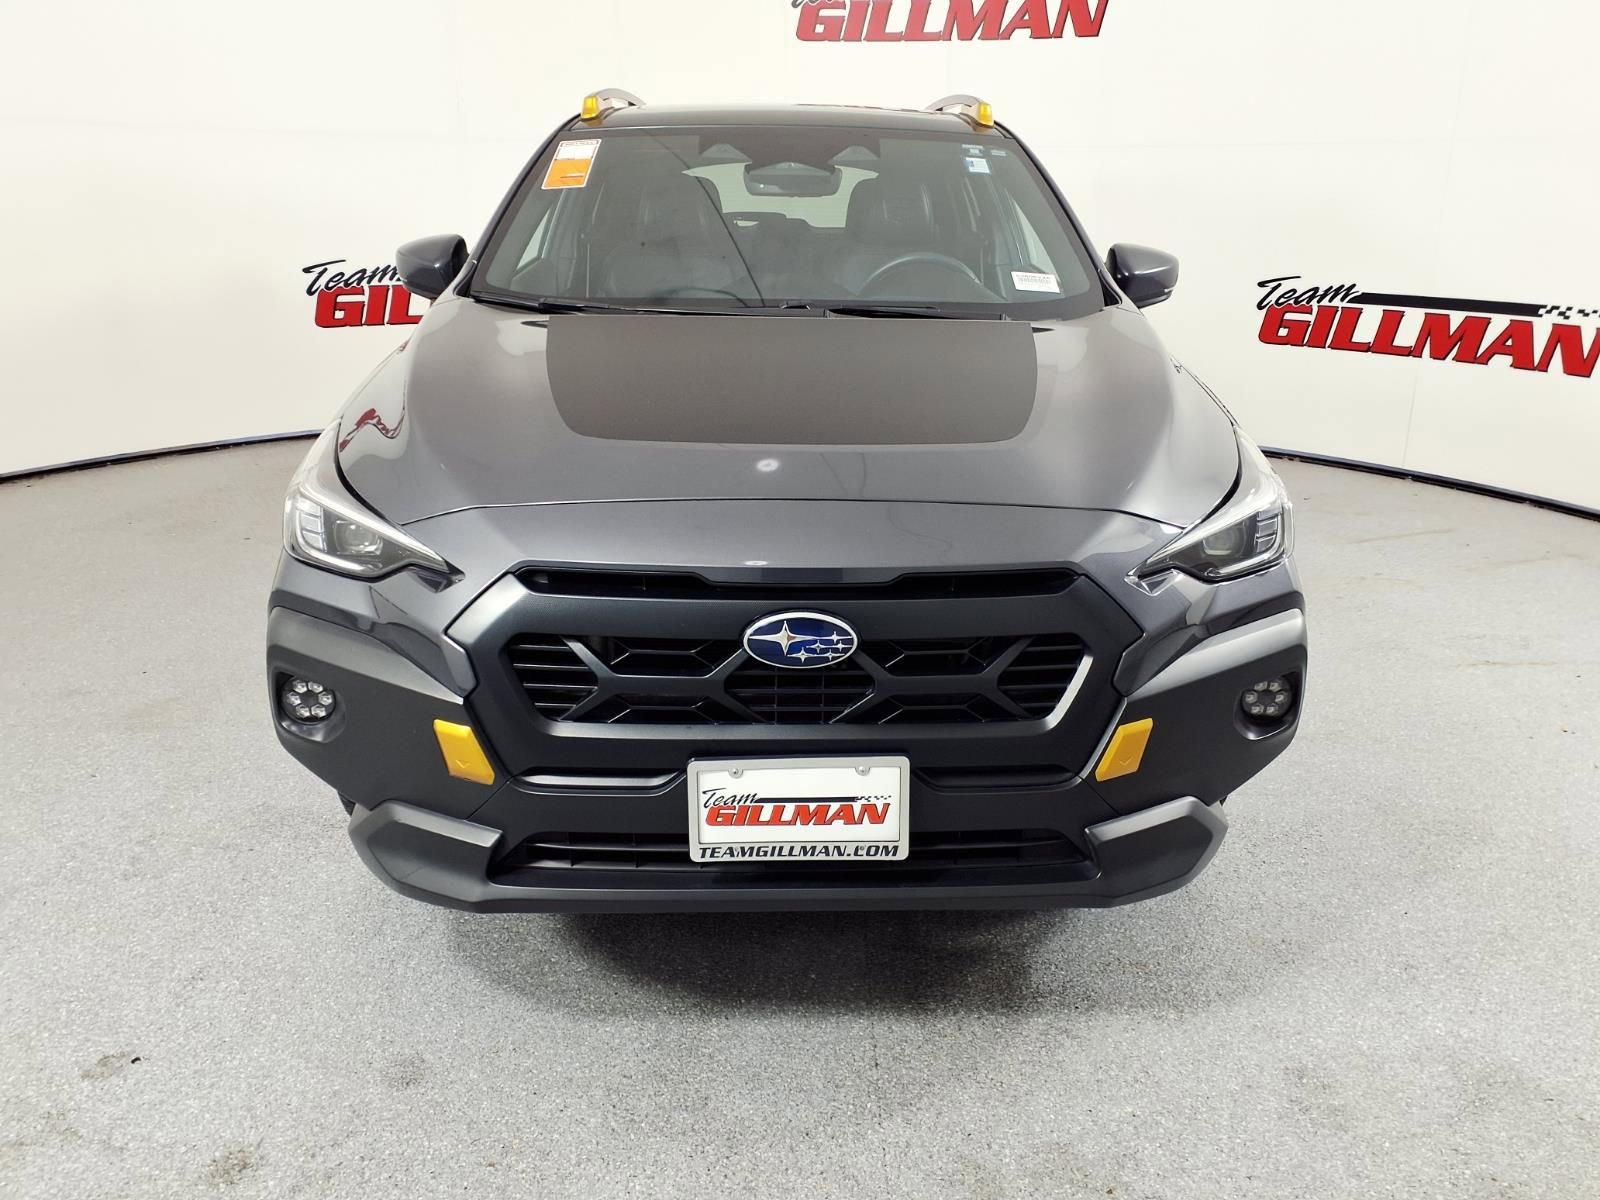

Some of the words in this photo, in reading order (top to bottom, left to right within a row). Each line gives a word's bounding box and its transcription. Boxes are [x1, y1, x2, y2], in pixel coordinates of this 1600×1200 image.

[796, 0, 1108, 42] GILLMAN
[302, 259, 398, 296] Team
[1256, 275, 1360, 311] Team
[1258, 303, 1600, 378] GILLMAN
[702, 787, 758, 809] Team
[705, 803, 891, 827] GILLMAN
[699, 845, 899, 859] TEAMGILLMAN.COM
